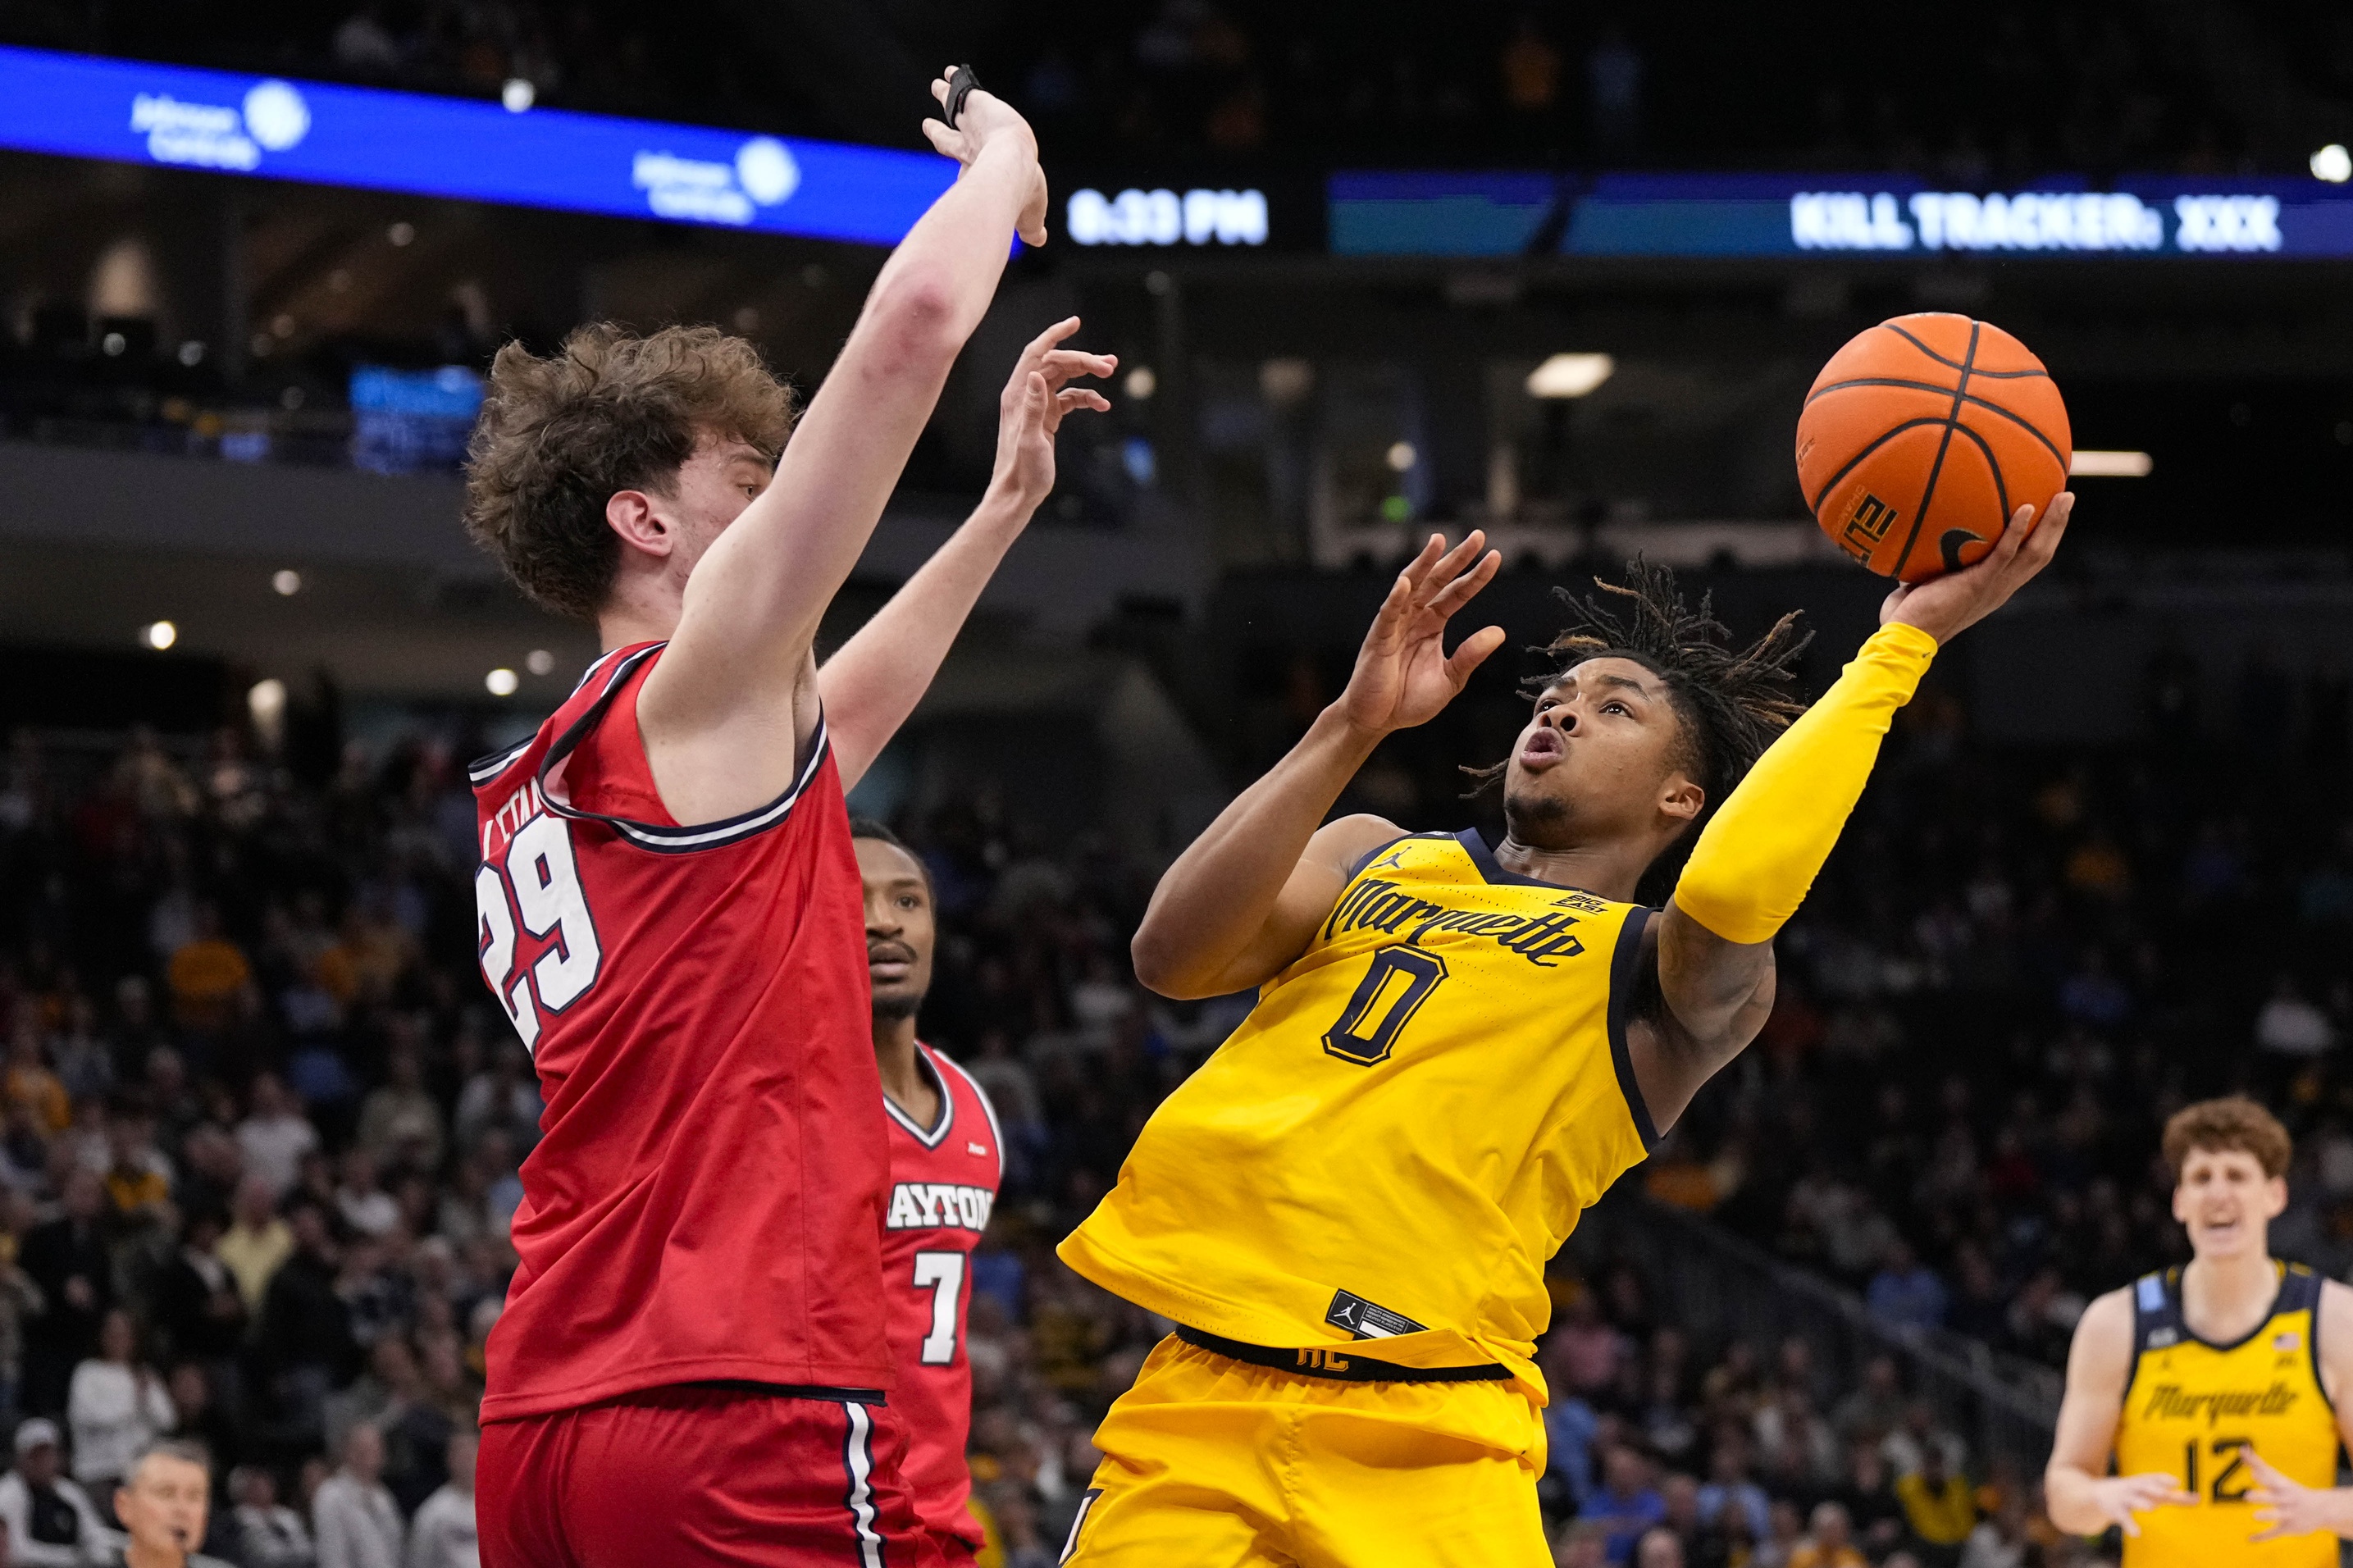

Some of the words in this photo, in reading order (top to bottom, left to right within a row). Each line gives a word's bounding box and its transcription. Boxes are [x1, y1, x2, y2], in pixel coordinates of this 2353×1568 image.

[1183, 188, 1269, 246] PM
[1790, 192, 1914, 250] KILL
[1908, 192, 2164, 250] TRACKER:
[2173, 194, 2282, 253] XXX
[1324, 877, 1586, 968] Marquette
[1556, 898, 1609, 913] EAST
[1566, 894, 1607, 905] BIG
[475, 810, 604, 1062] 29
[1320, 944, 1450, 1068] 0
[887, 1182, 995, 1232] AYTON
[912, 1249, 968, 1365] 7
[2186, 1437, 2254, 1504] 12
